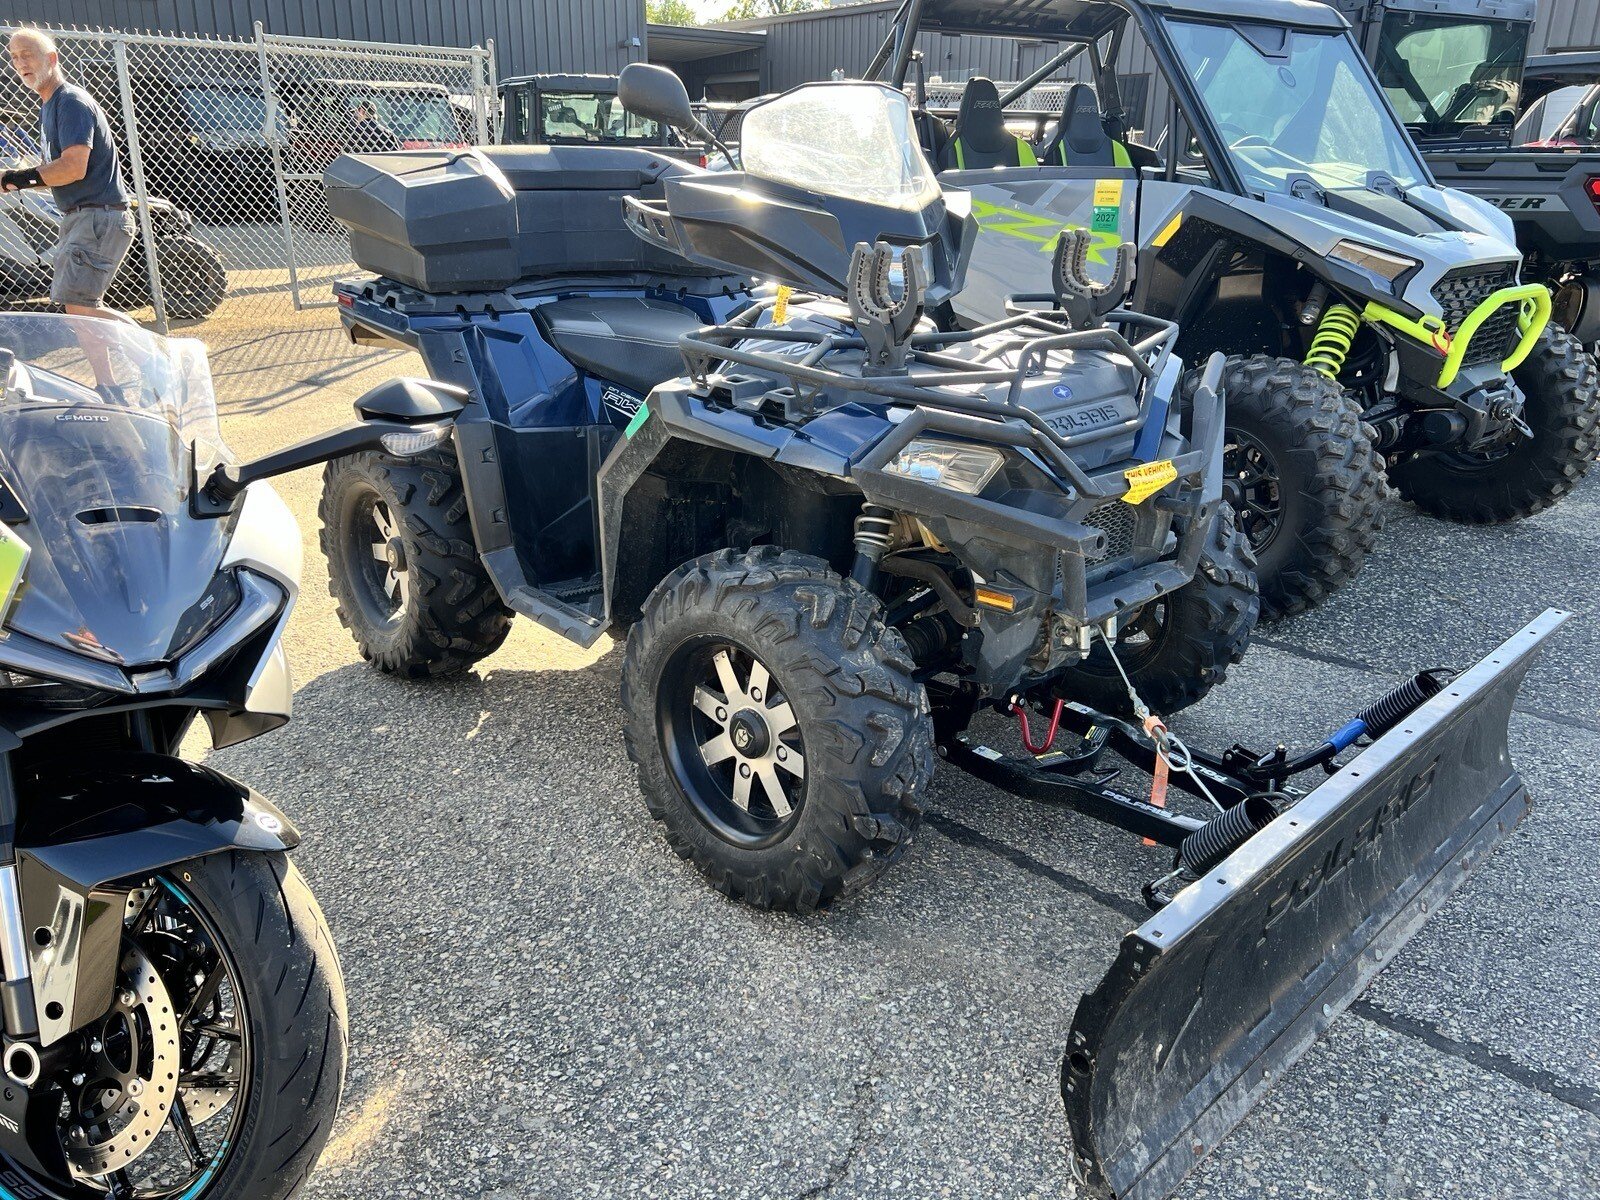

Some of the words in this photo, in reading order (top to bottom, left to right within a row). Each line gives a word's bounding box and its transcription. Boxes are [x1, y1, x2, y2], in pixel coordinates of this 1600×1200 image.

[1095, 213, 1116, 222] 2027
[602, 390, 641, 414] AW
[55, 414, 109, 422] CFMOTO
[1101, 789, 1174, 819] POLARIS
